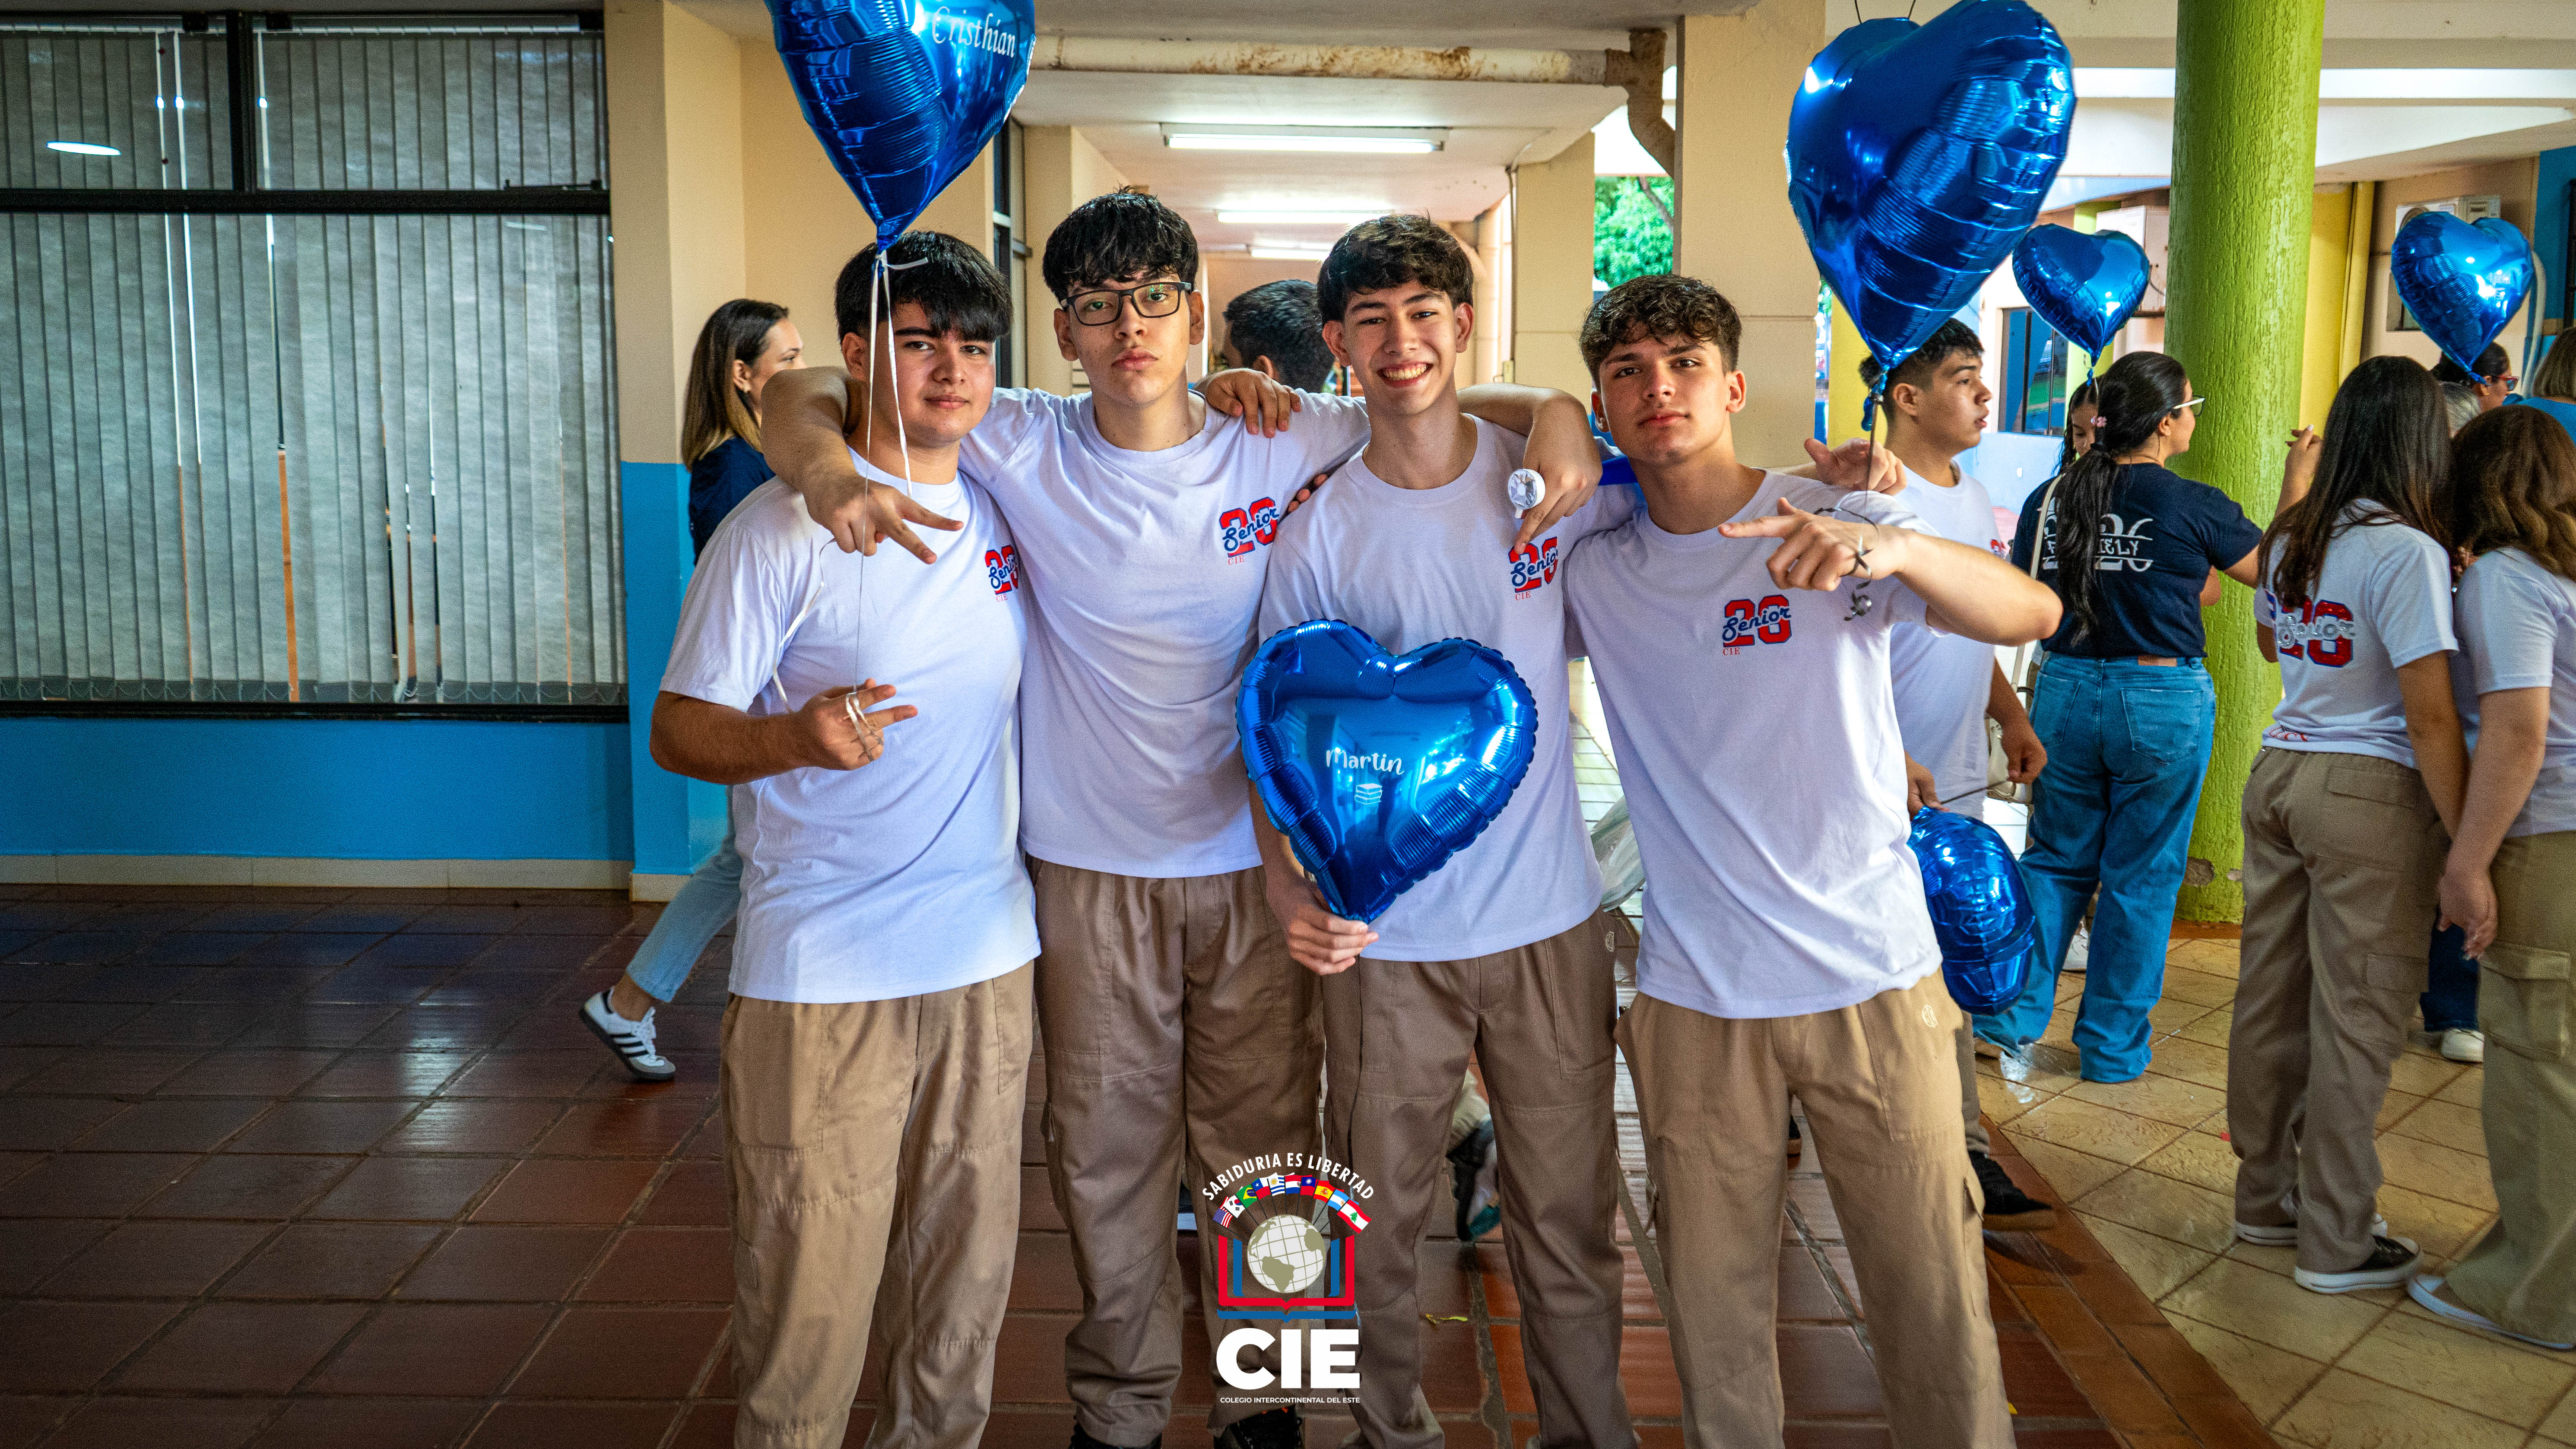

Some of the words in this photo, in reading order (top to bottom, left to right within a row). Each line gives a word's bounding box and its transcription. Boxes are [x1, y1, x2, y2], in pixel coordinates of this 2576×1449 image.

[932, 6, 1015, 57] Cristhian
[1222, 508, 1279, 552] Senior
[1228, 555, 1244, 565] CIE
[1510, 549, 1558, 587] Senio
[996, 593, 1008, 602] CIE
[1515, 591, 1531, 601] CIE
[1722, 607, 1791, 641] Senior
[1723, 594, 1792, 647] 26
[1723, 647, 1740, 656] CIE
[1326, 749, 1404, 775] Martin
